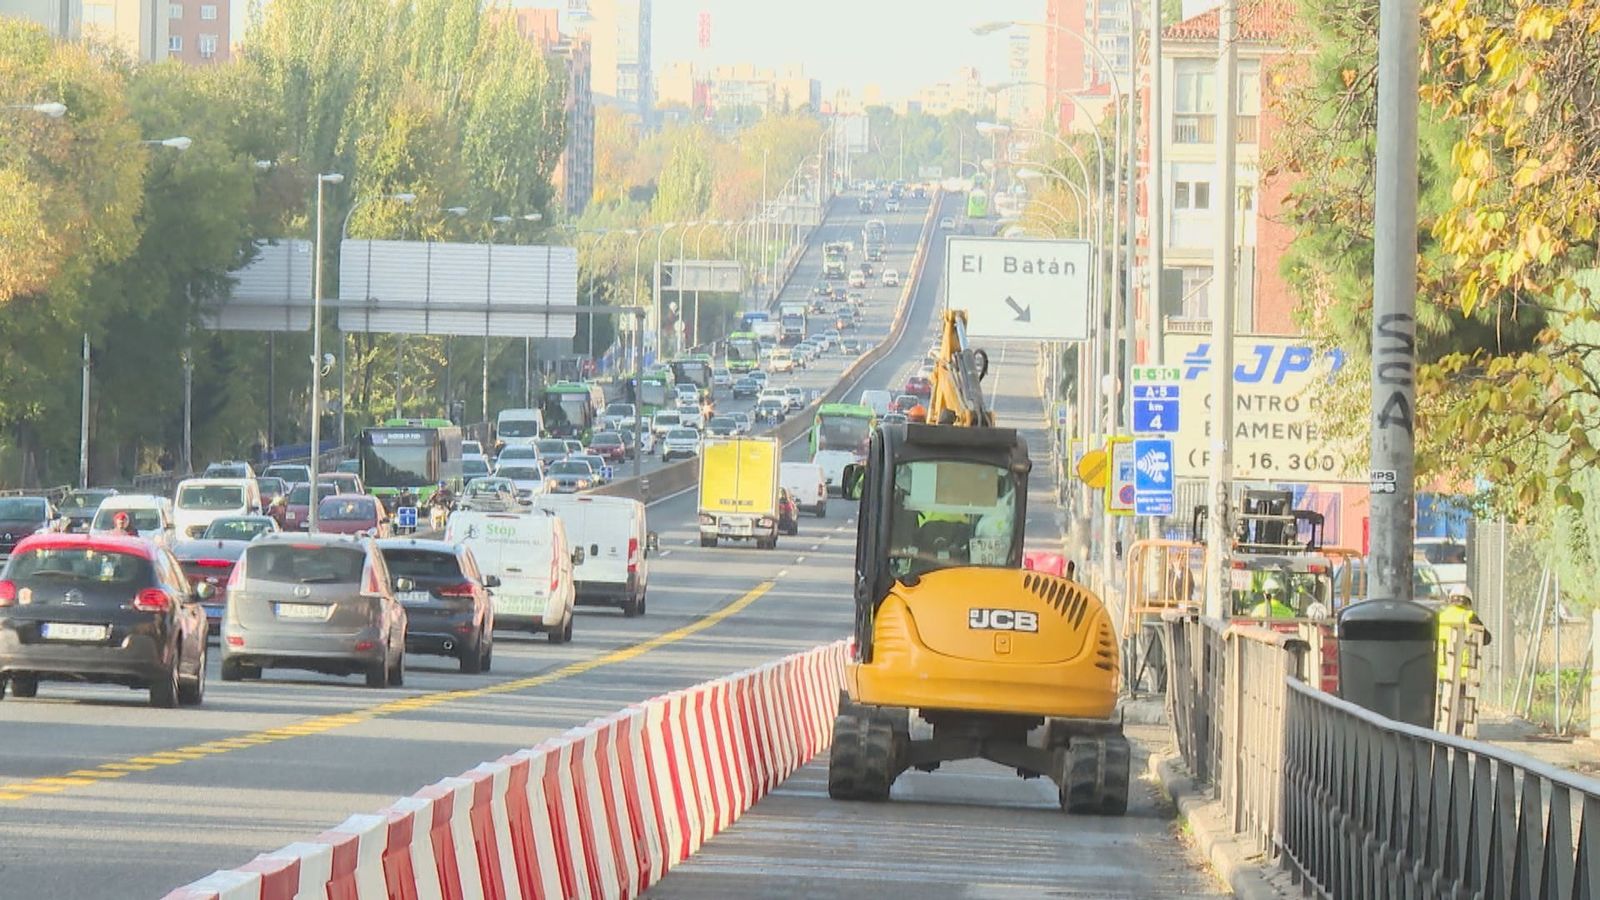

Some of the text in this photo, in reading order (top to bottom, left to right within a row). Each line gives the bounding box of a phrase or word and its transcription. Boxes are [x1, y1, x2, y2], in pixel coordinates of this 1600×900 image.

[962, 255, 1076, 275] El Batán
[1148, 401, 1164, 412] km
[1149, 414, 1163, 430] 4
[969, 609, 1038, 632] JCB
